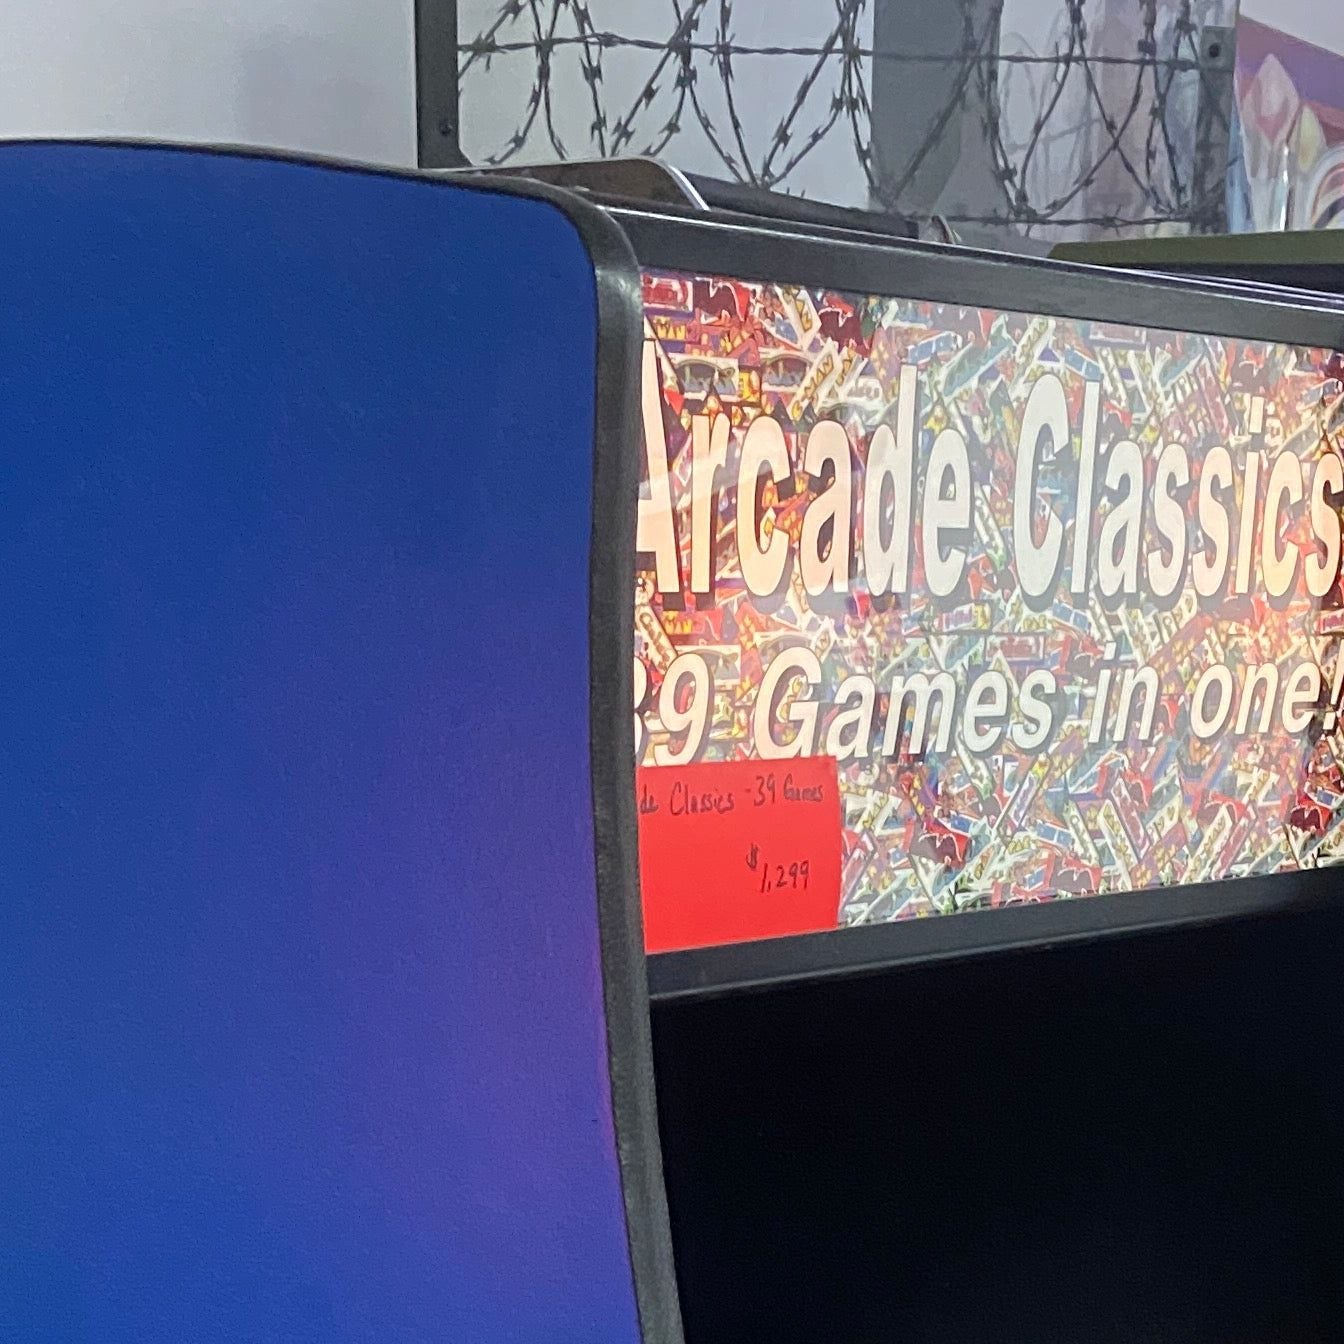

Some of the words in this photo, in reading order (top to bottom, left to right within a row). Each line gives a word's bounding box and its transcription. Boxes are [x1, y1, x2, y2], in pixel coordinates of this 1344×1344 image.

[1015, 373, 1344, 597] Classics
[754, 647, 1055, 764] Games
[1088, 640, 1160, 743] in
[670, 782, 734, 816] Classics
[760, 860, 809, 893] 1,299
